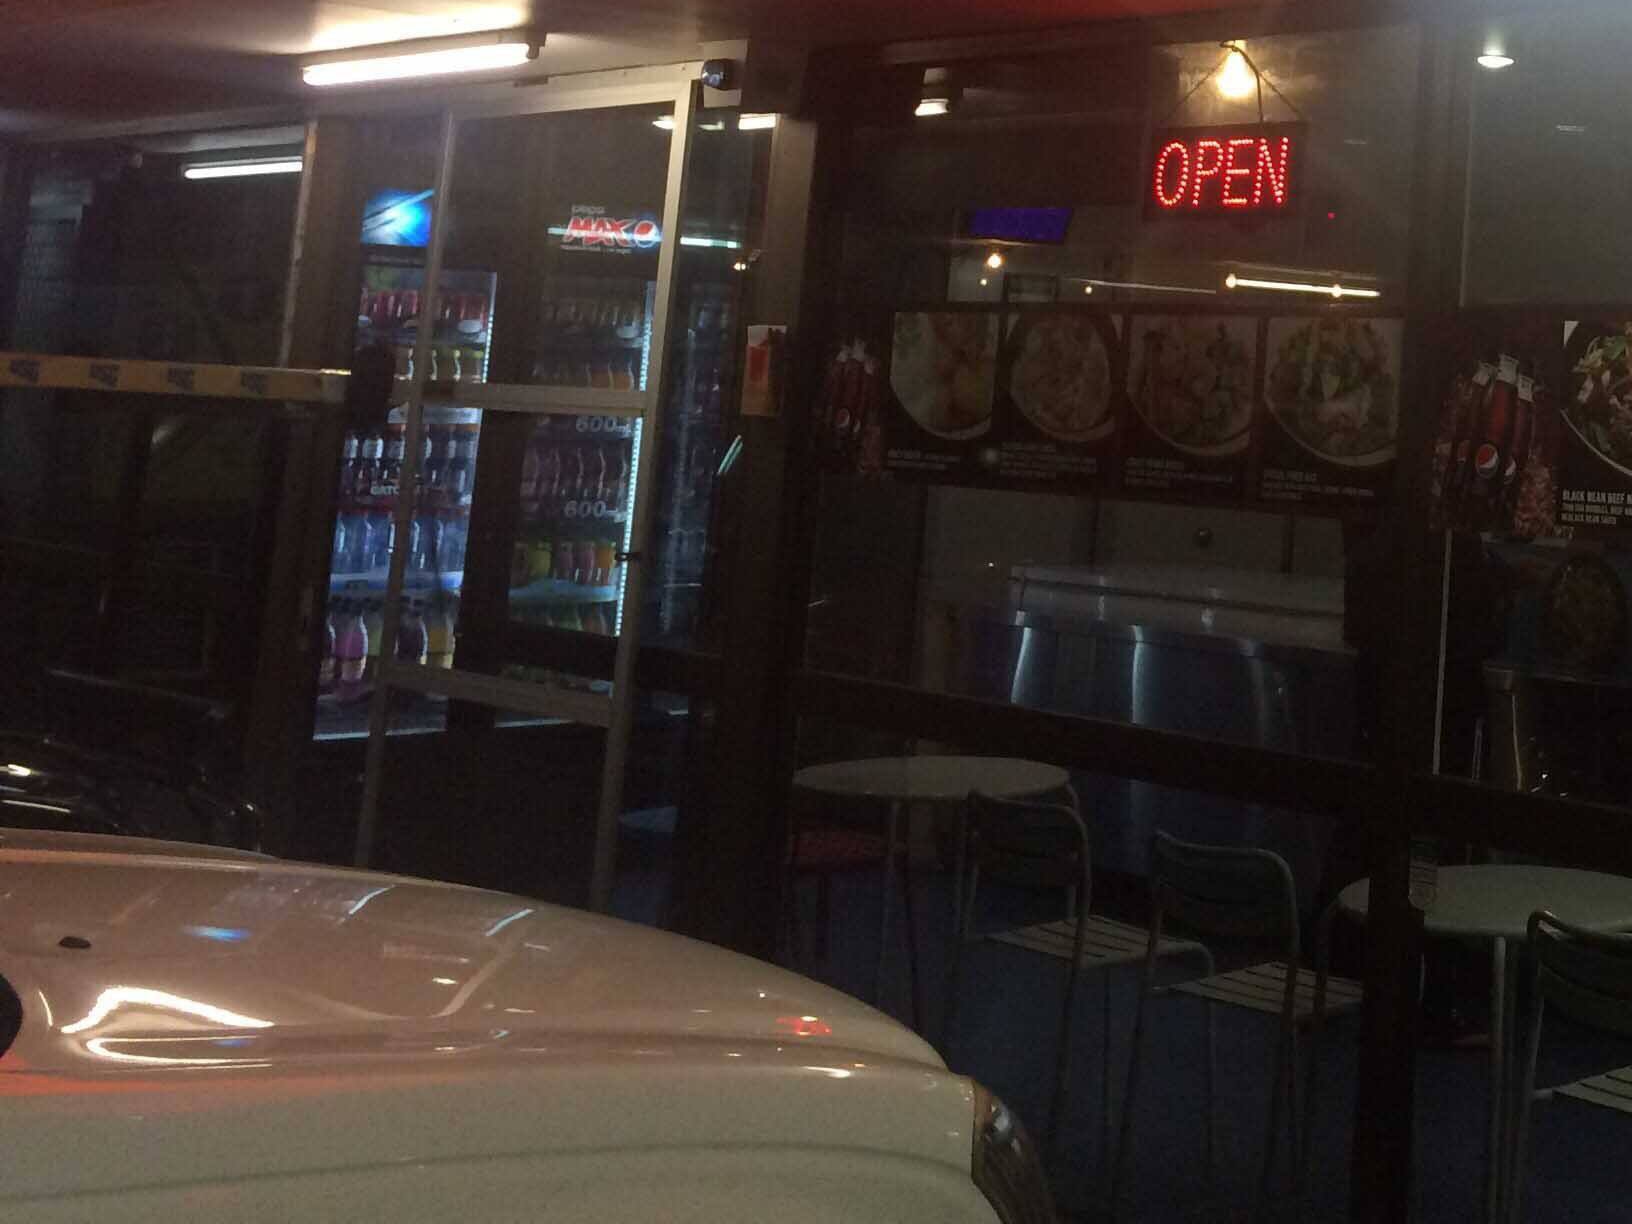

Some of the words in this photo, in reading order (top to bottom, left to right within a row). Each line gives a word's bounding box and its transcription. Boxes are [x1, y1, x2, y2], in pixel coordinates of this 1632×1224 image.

[1155, 136, 1290, 208] OPEN
[562, 216, 637, 248] MAX
[1607, 492, 1625, 505] BEEF
